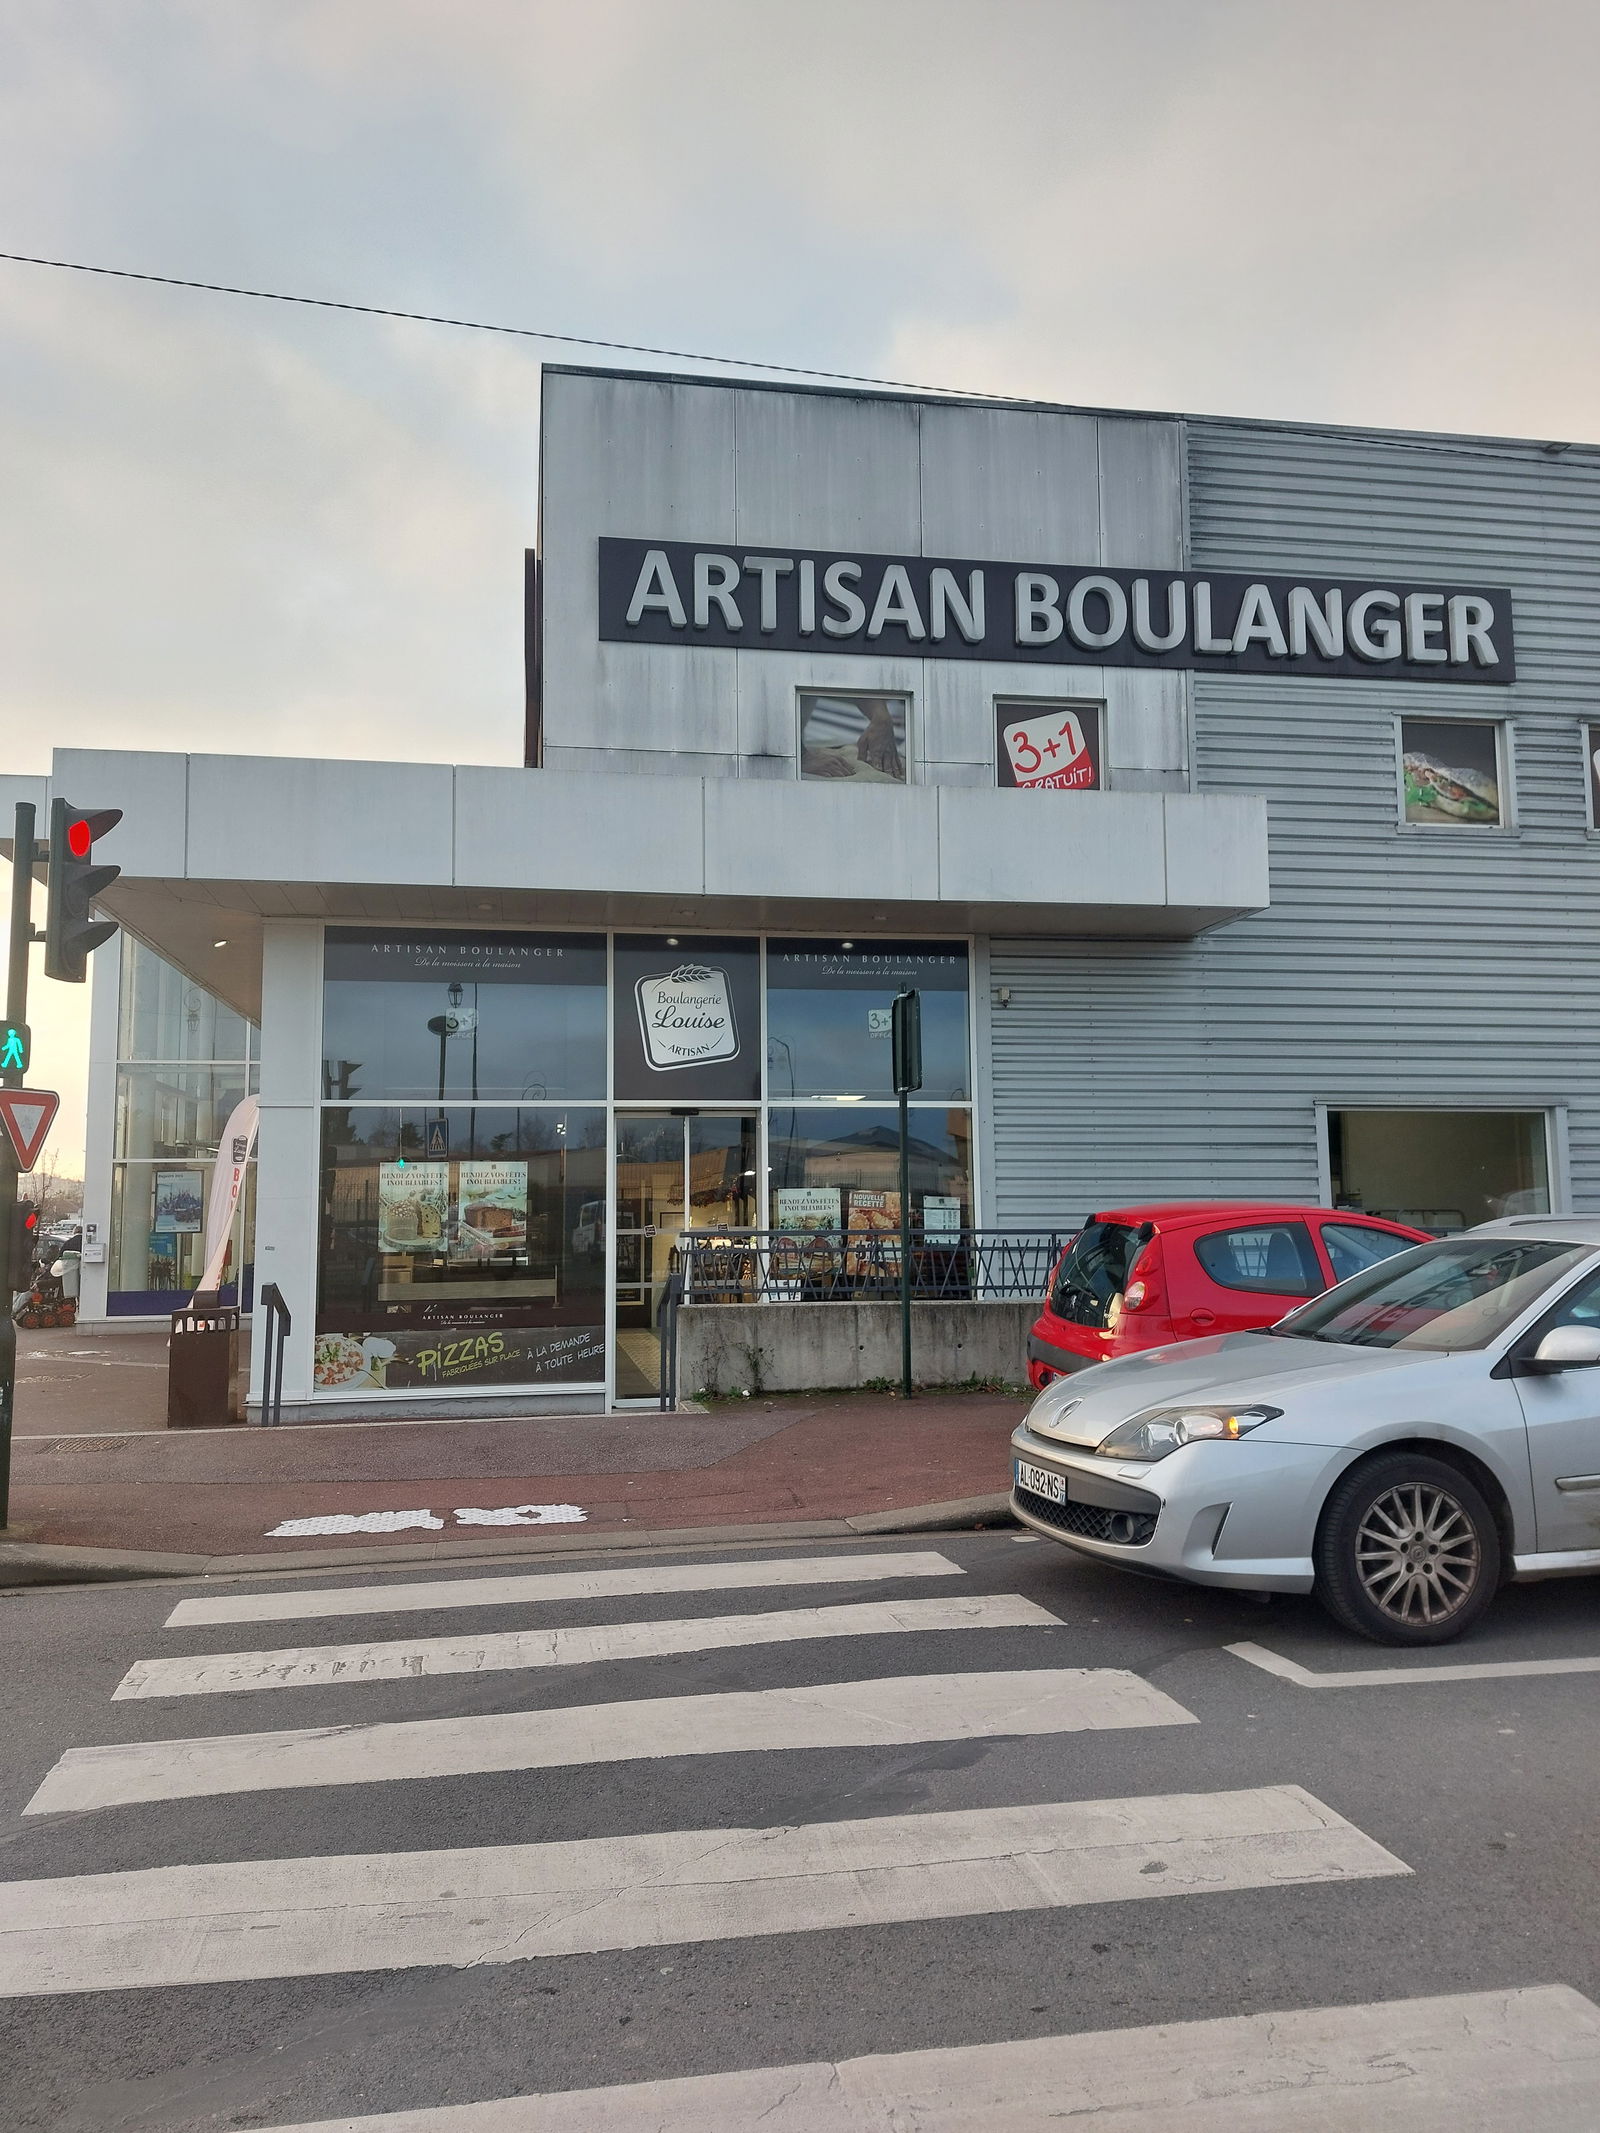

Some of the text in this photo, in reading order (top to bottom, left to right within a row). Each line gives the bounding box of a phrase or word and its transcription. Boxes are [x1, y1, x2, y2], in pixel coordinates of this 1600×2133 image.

[625, 549, 1499, 667] ARTISAN BOULANGER
[1012, 721, 1077, 774] 3+1
[370, 944, 564, 957] ARTISAN BOULANGER
[782, 954, 956, 964] ARTISAN BOULANGER
[414, 957, 430, 966] De
[431, 957, 440, 967] la
[441, 960, 475, 968] moisson
[482, 958, 491, 968] la
[821, 966, 836, 975] De
[836, 966, 845, 975] la
[882, 966, 890, 975] la
[657, 991, 722, 1009] Boulangerie
[651, 1005, 726, 1029] Louise
[668, 1043, 711, 1057] ARTISAN
[853, 1193, 885, 1201] NOUVELLE
[853, 1200, 884, 1208] RECETTE
[536, 1347, 548, 1359] LA
[550, 1332, 591, 1354] DEMANDE
[484, 1355, 500, 1367] SUR
[499, 1349, 521, 1362] PLACE
[544, 1355, 574, 1371] TOUTE
[577, 1343, 605, 1363] HEURE
[1020, 1463, 1059, 1499] AL-092-NS
